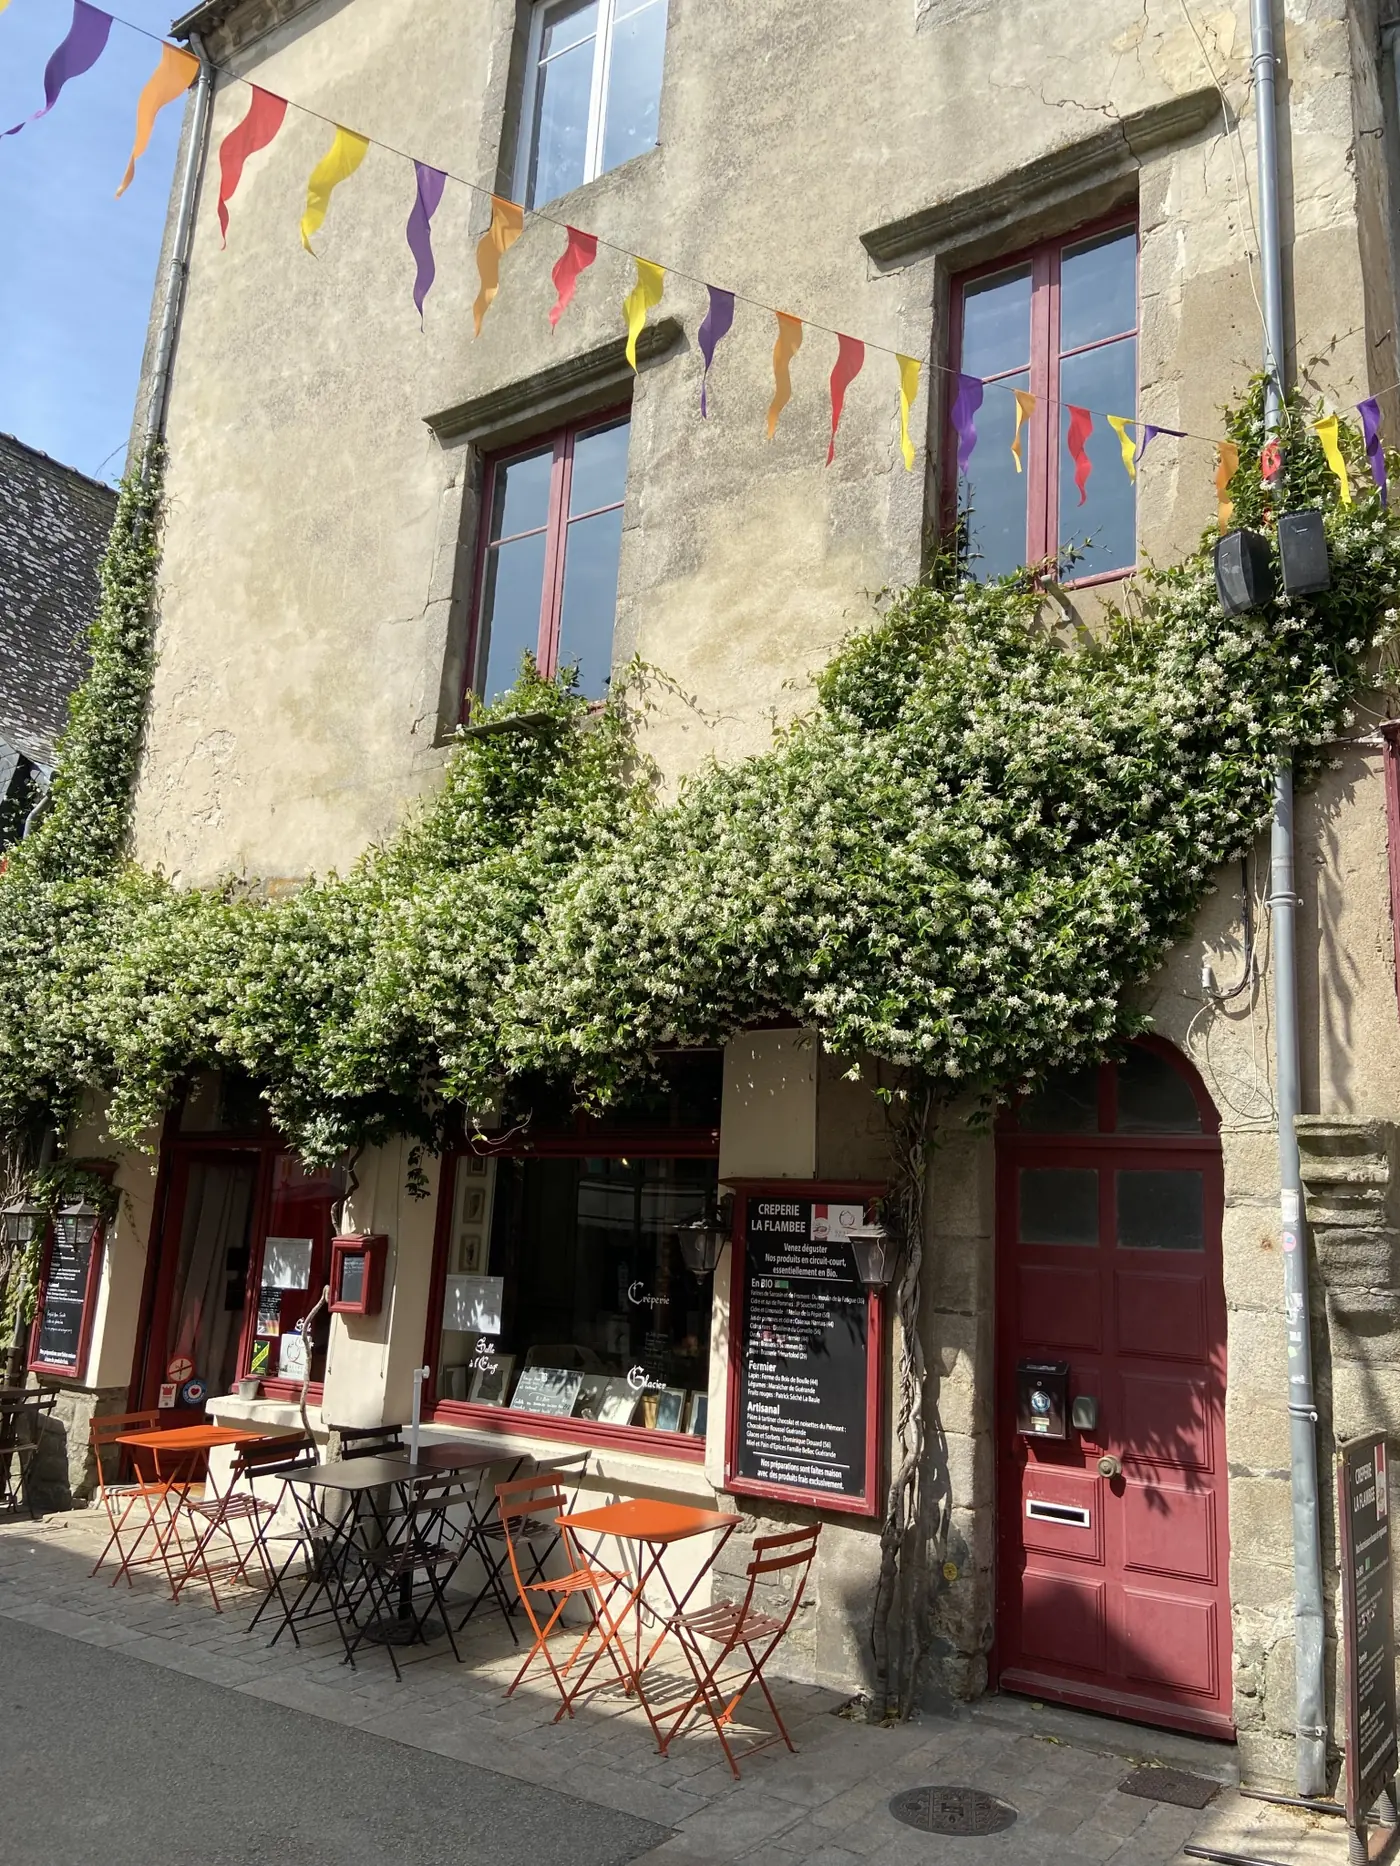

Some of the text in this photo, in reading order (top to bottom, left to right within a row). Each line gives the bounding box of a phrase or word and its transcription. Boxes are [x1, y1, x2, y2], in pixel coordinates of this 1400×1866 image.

[758, 1203, 800, 1216] CREPERIE
[751, 1220, 806, 1233] LA FLAMBEE
[784, 1243, 828, 1254] Venez déguster
[765, 1254, 776, 1262] Nos
[776, 1254, 800, 1264] produits
[773, 1266, 818, 1276] essentiellement
[752, 1278, 773, 1288] En BIO
[628, 1280, 670, 1310] Crêperie
[475, 1336, 495, 1354] Salle
[748, 1360, 776, 1372] Fermier
[627, 1364, 666, 1390] Glacier
[747, 1401, 780, 1415] Artisanal
[760, 1458, 842, 1478] Nos préparations sont faites maison
[769, 1470, 778, 1479] des
[778, 1472, 798, 1482] produits
[798, 1474, 808, 1484] frais
[808, 1476, 844, 1490] exclusivement.
